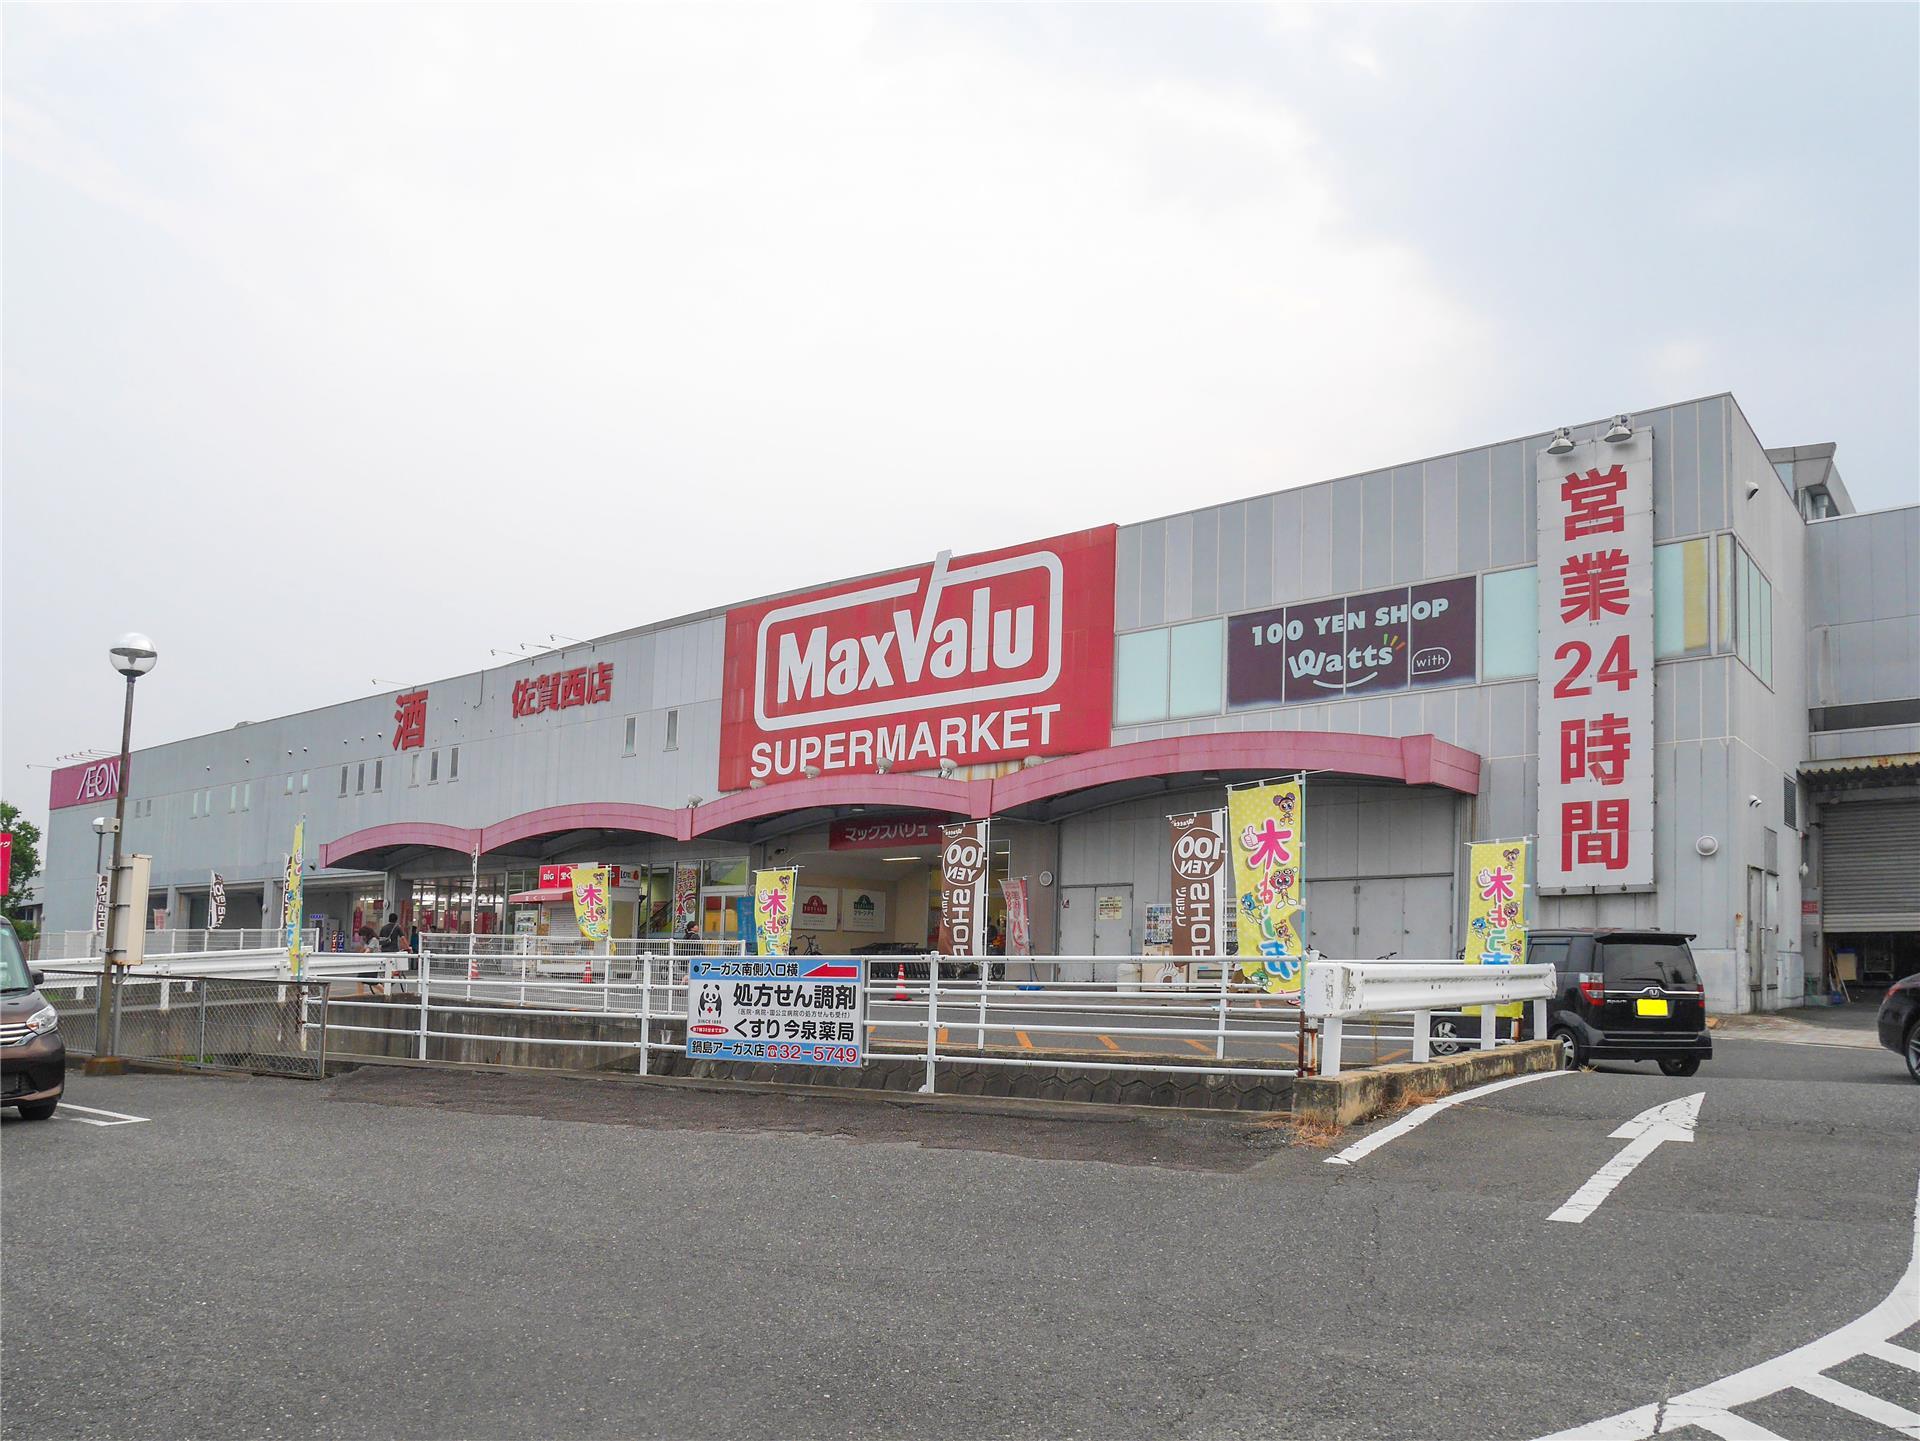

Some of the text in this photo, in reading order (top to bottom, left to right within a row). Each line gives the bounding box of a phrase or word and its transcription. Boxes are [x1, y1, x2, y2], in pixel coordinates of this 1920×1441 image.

[777, 552, 1033, 703] MaxValu
[1252, 598, 1448, 646] 100 YEN SHOP
[1288, 645, 1393, 678] Watts
[1416, 654, 1445, 667] with
[1553, 464, 1637, 871] 営業24時間
[511, 661, 614, 719] 佐賀西店
[392, 690, 428, 750] 酒
[750, 704, 1059, 778] SUPERMARKET
[845, 823, 929, 841] マックスバリュ
[543, 870, 554, 880] BIG
[701, 963, 798, 977] アーガス南側入口横
[733, 983, 857, 1010] 処方せん調剤
[692, 1041, 857, 1063] 鍋島アーガス店 32-5749
